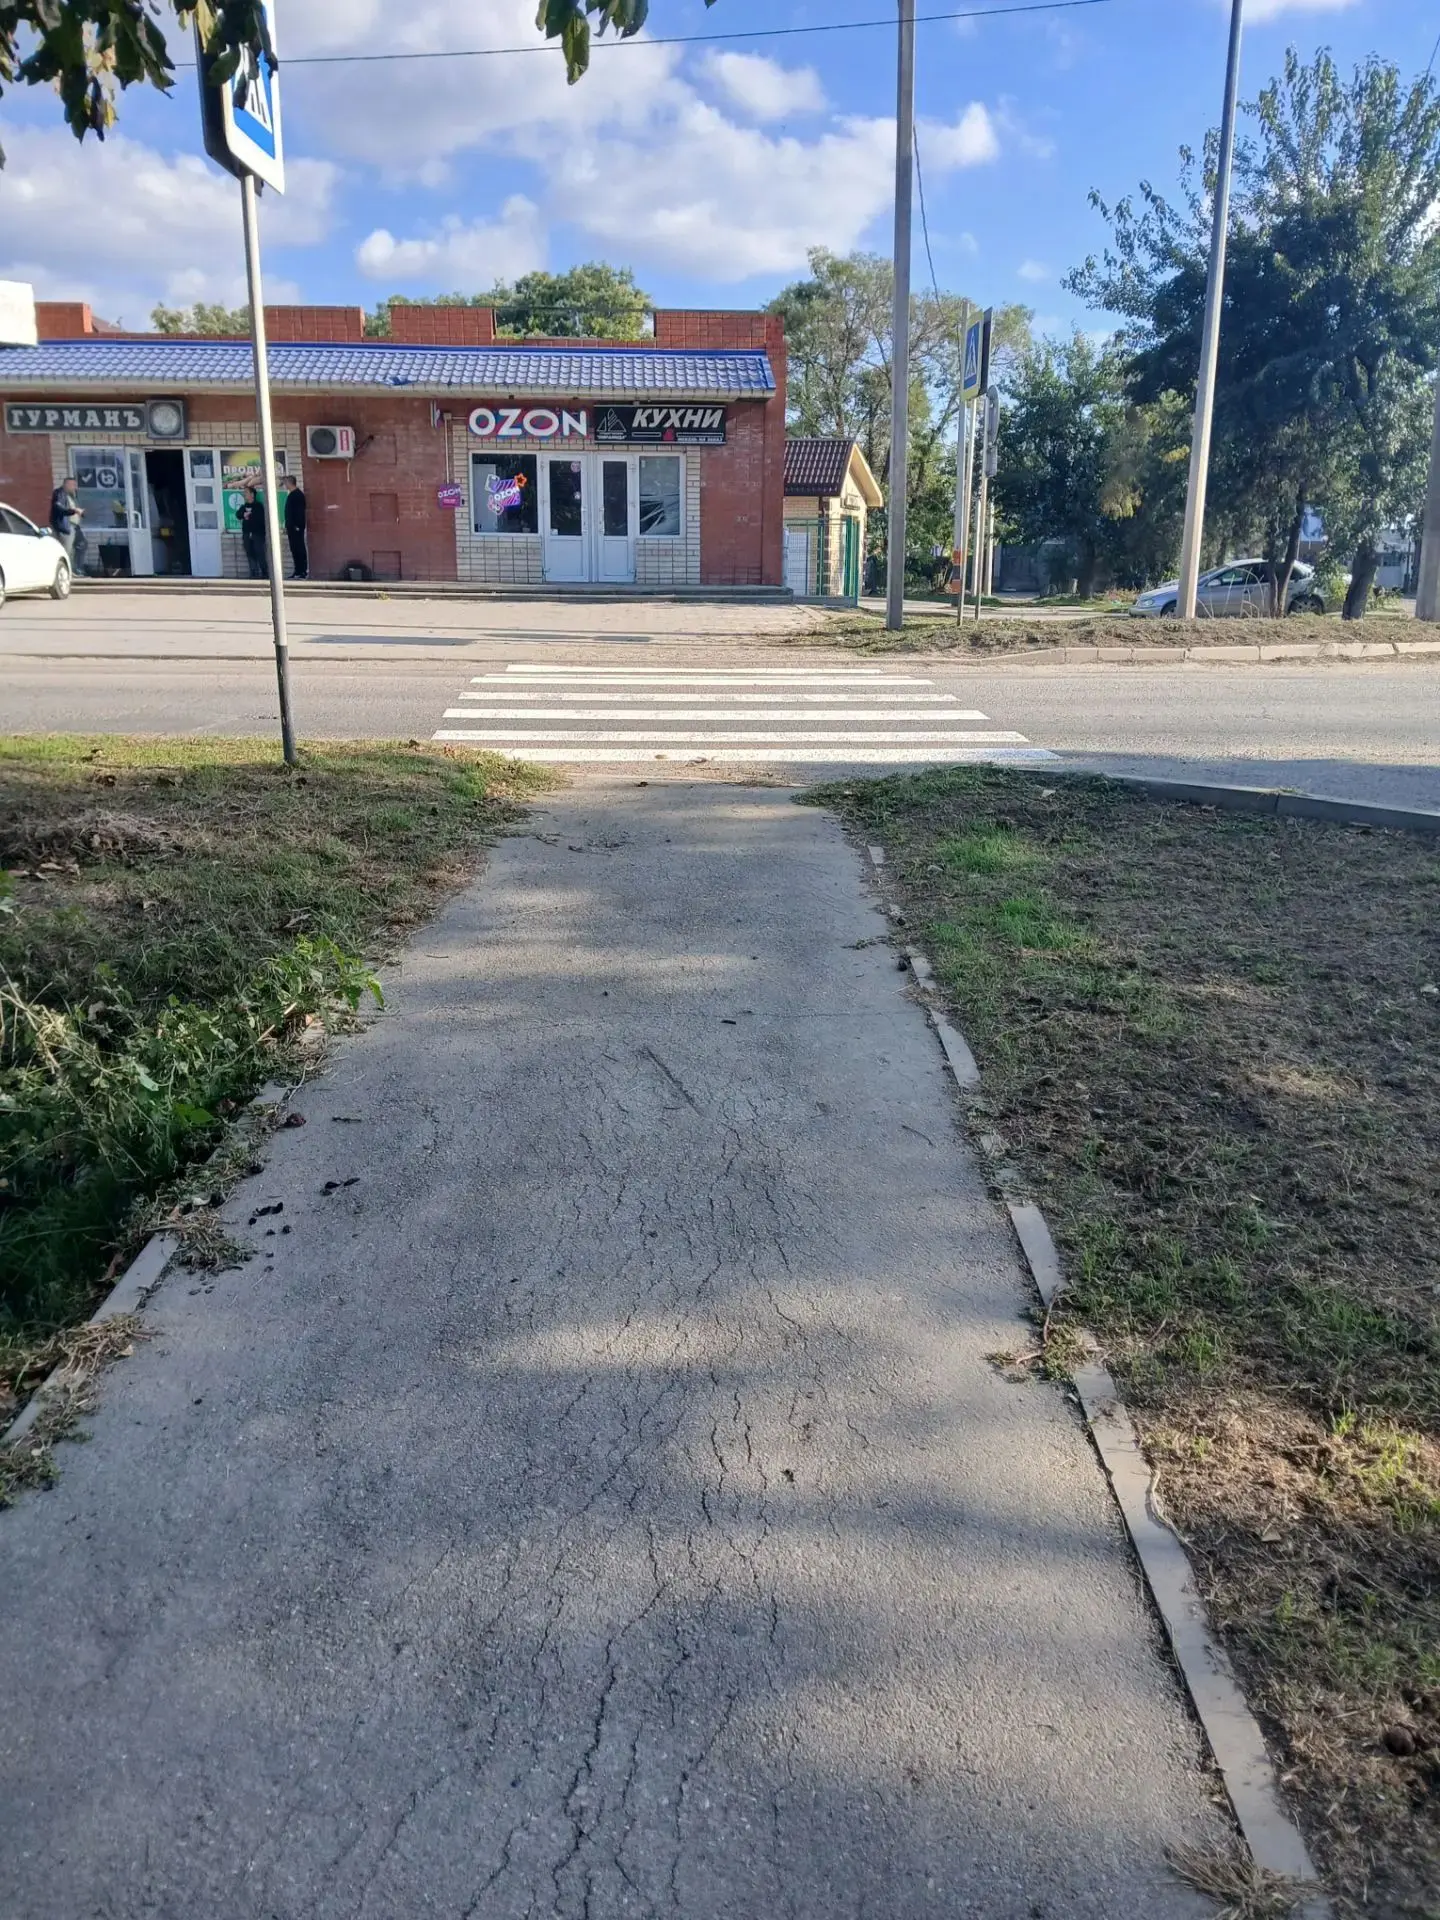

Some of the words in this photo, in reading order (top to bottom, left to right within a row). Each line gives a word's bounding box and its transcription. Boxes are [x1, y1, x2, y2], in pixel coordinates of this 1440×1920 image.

[11, 409, 141, 427] ГУРМАНЪ
[469, 408, 587, 436] OZON
[632, 408, 723, 429] КУХНИ
[494, 486, 520, 501] OZON
